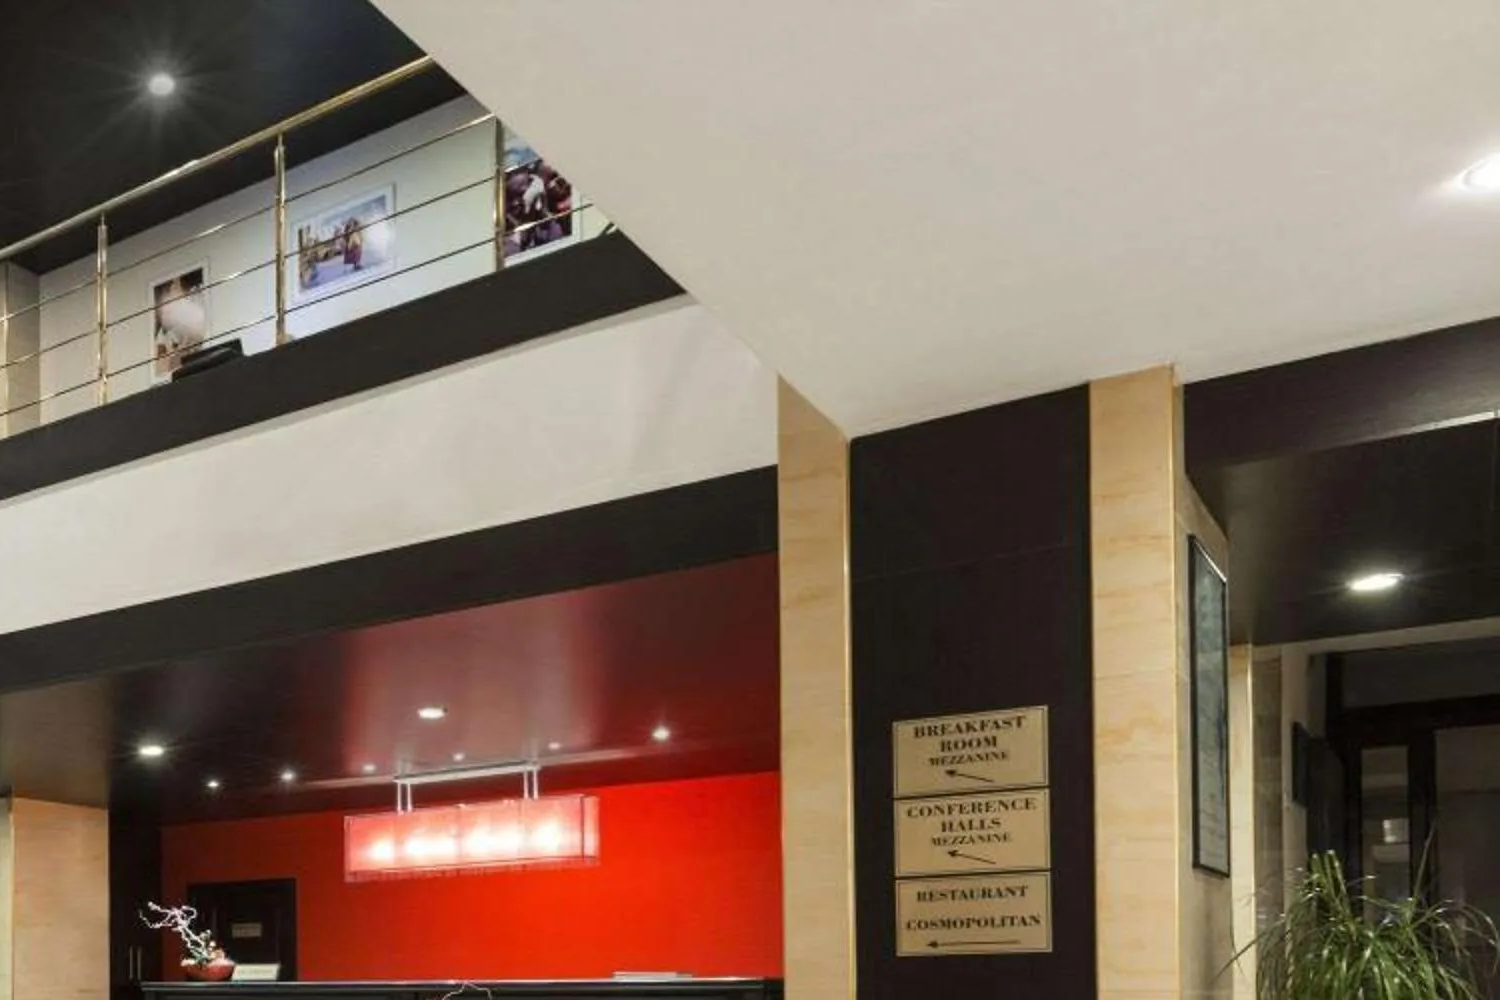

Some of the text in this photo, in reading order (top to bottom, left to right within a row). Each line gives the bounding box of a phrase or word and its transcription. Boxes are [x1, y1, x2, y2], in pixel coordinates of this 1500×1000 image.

[913, 715, 1026, 738] BREAKFAST
[940, 736, 997, 752] ROOM
[928, 751, 1008, 766] MEZZANINE
[907, 798, 1037, 818] CONFERENCE
[941, 818, 1001, 833] HALLS
[931, 832, 1011, 847] MEZZANINE
[916, 886, 1028, 902] RESTAURANT
[906, 915, 1041, 931] COSMOPOLITAN
